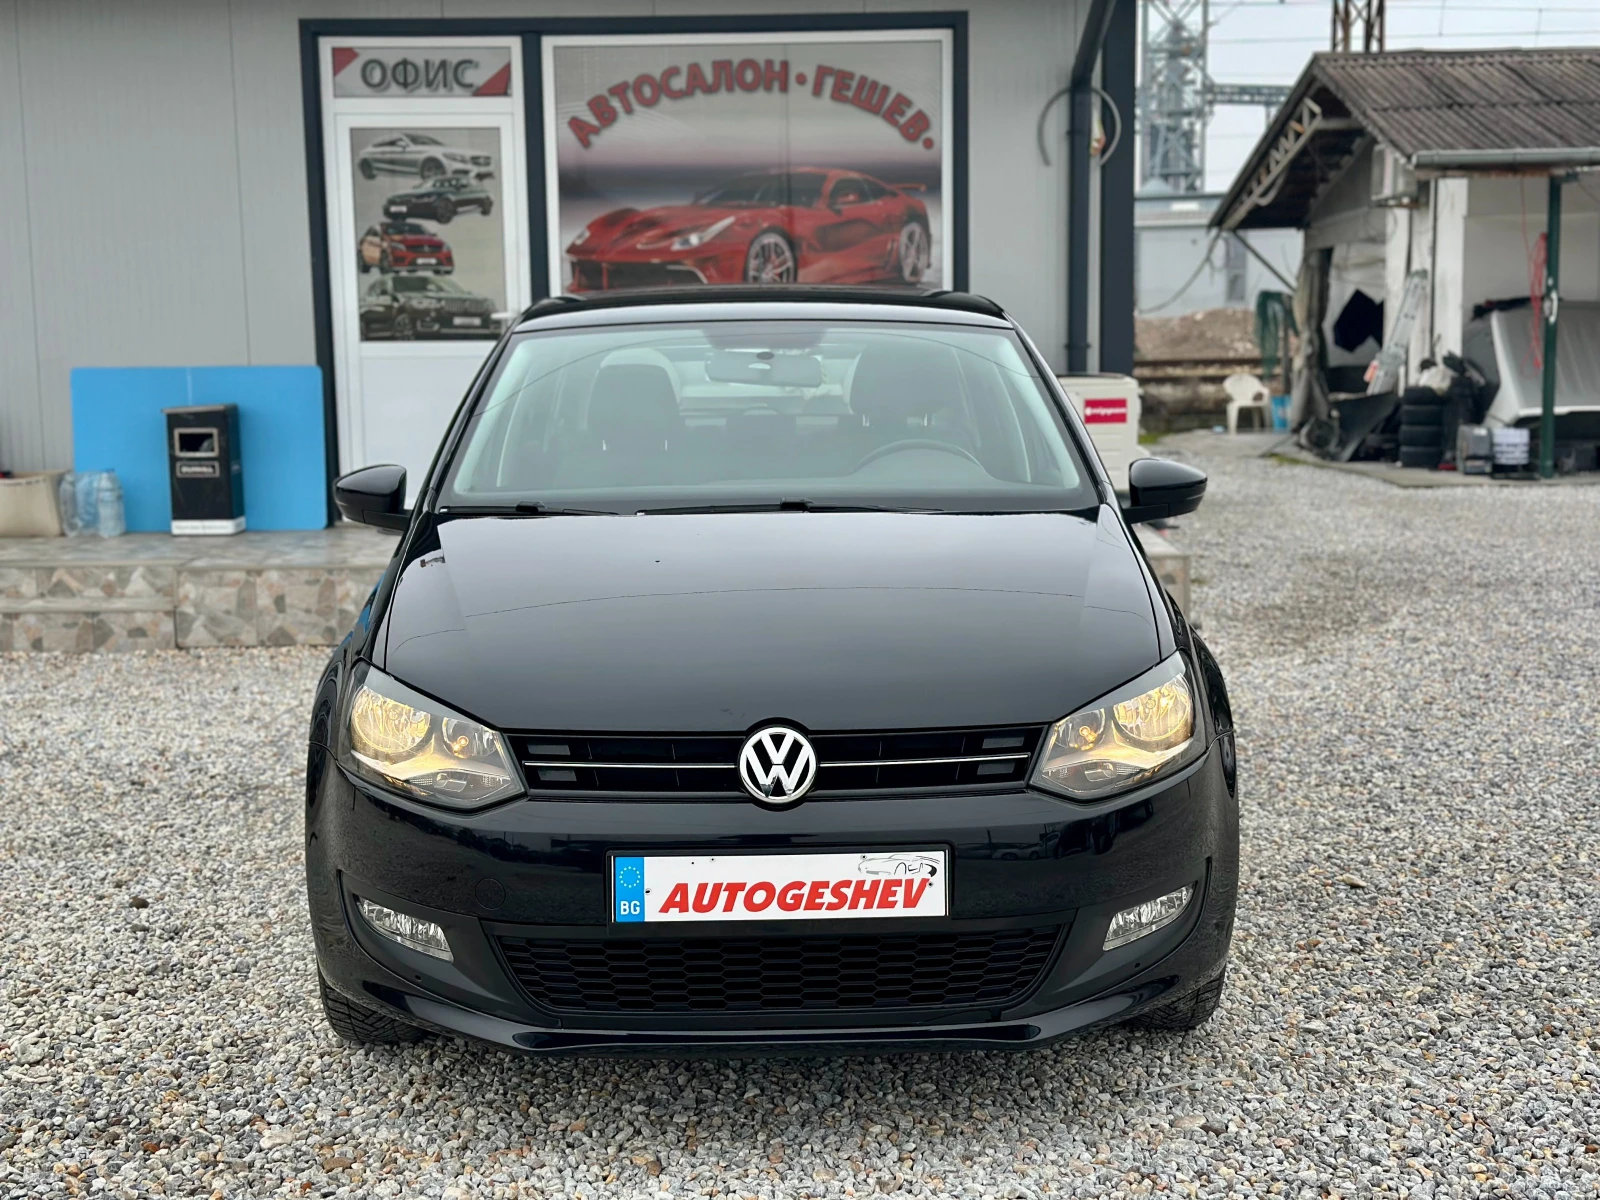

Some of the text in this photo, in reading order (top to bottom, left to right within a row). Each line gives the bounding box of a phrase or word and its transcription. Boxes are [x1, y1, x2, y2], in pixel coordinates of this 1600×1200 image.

[360, 57, 478, 91] ОФИС
[567, 58, 790, 150] АВТОСАЛОН
[741, 728, 815, 801] VW
[620, 877, 930, 915] BG AUTOGESHEV
